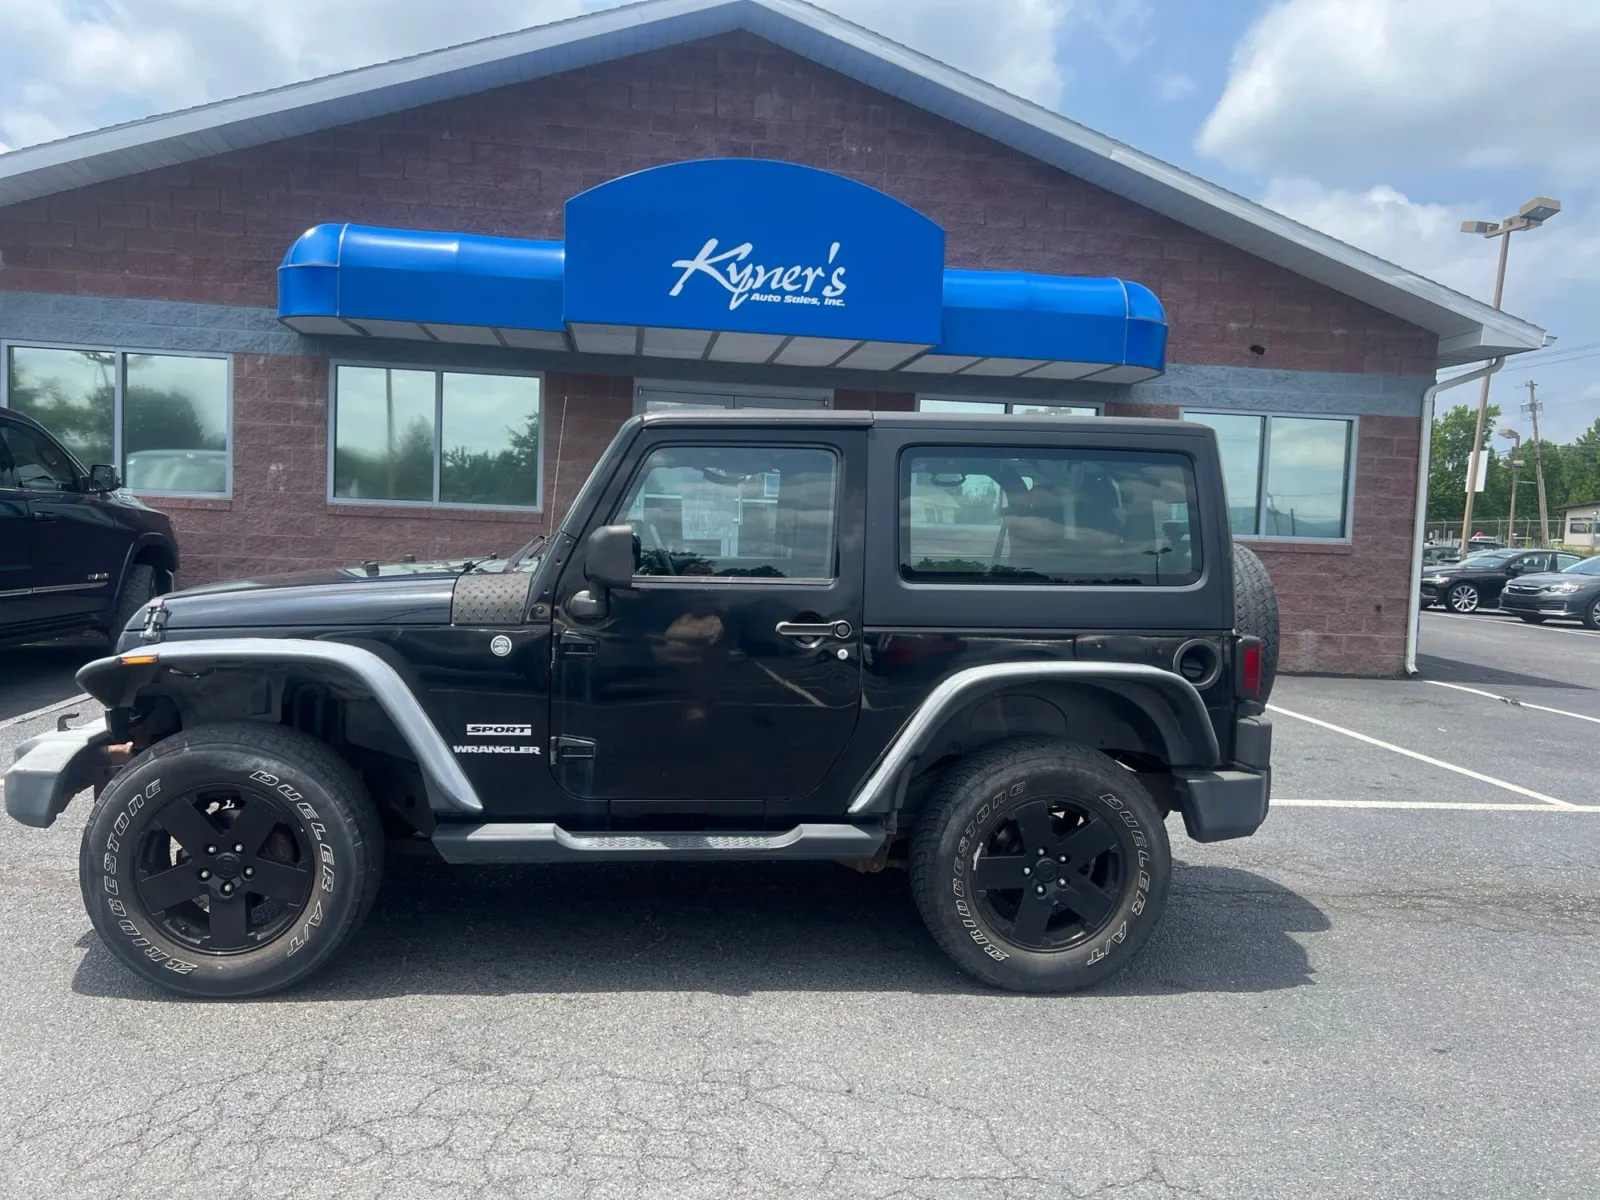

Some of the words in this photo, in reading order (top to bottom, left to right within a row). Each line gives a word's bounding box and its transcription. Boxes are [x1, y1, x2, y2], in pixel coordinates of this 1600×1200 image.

[669, 238, 847, 311] Kyner's
[750, 293, 782, 303] Auto
[783, 295, 821, 306] Sales,
[824, 297, 846, 307] Inc.
[453, 745, 541, 755] WRANGLER
[469, 725, 529, 735] SPORT
[249, 770, 335, 893] DUELER
[1099, 793, 1150, 916] DUELER
[104, 779, 199, 975] BRIDGESTONE
[952, 781, 1026, 962] BRIDGESTONE
[287, 900, 324, 957] A/T
[1087, 921, 1127, 966] A/T
